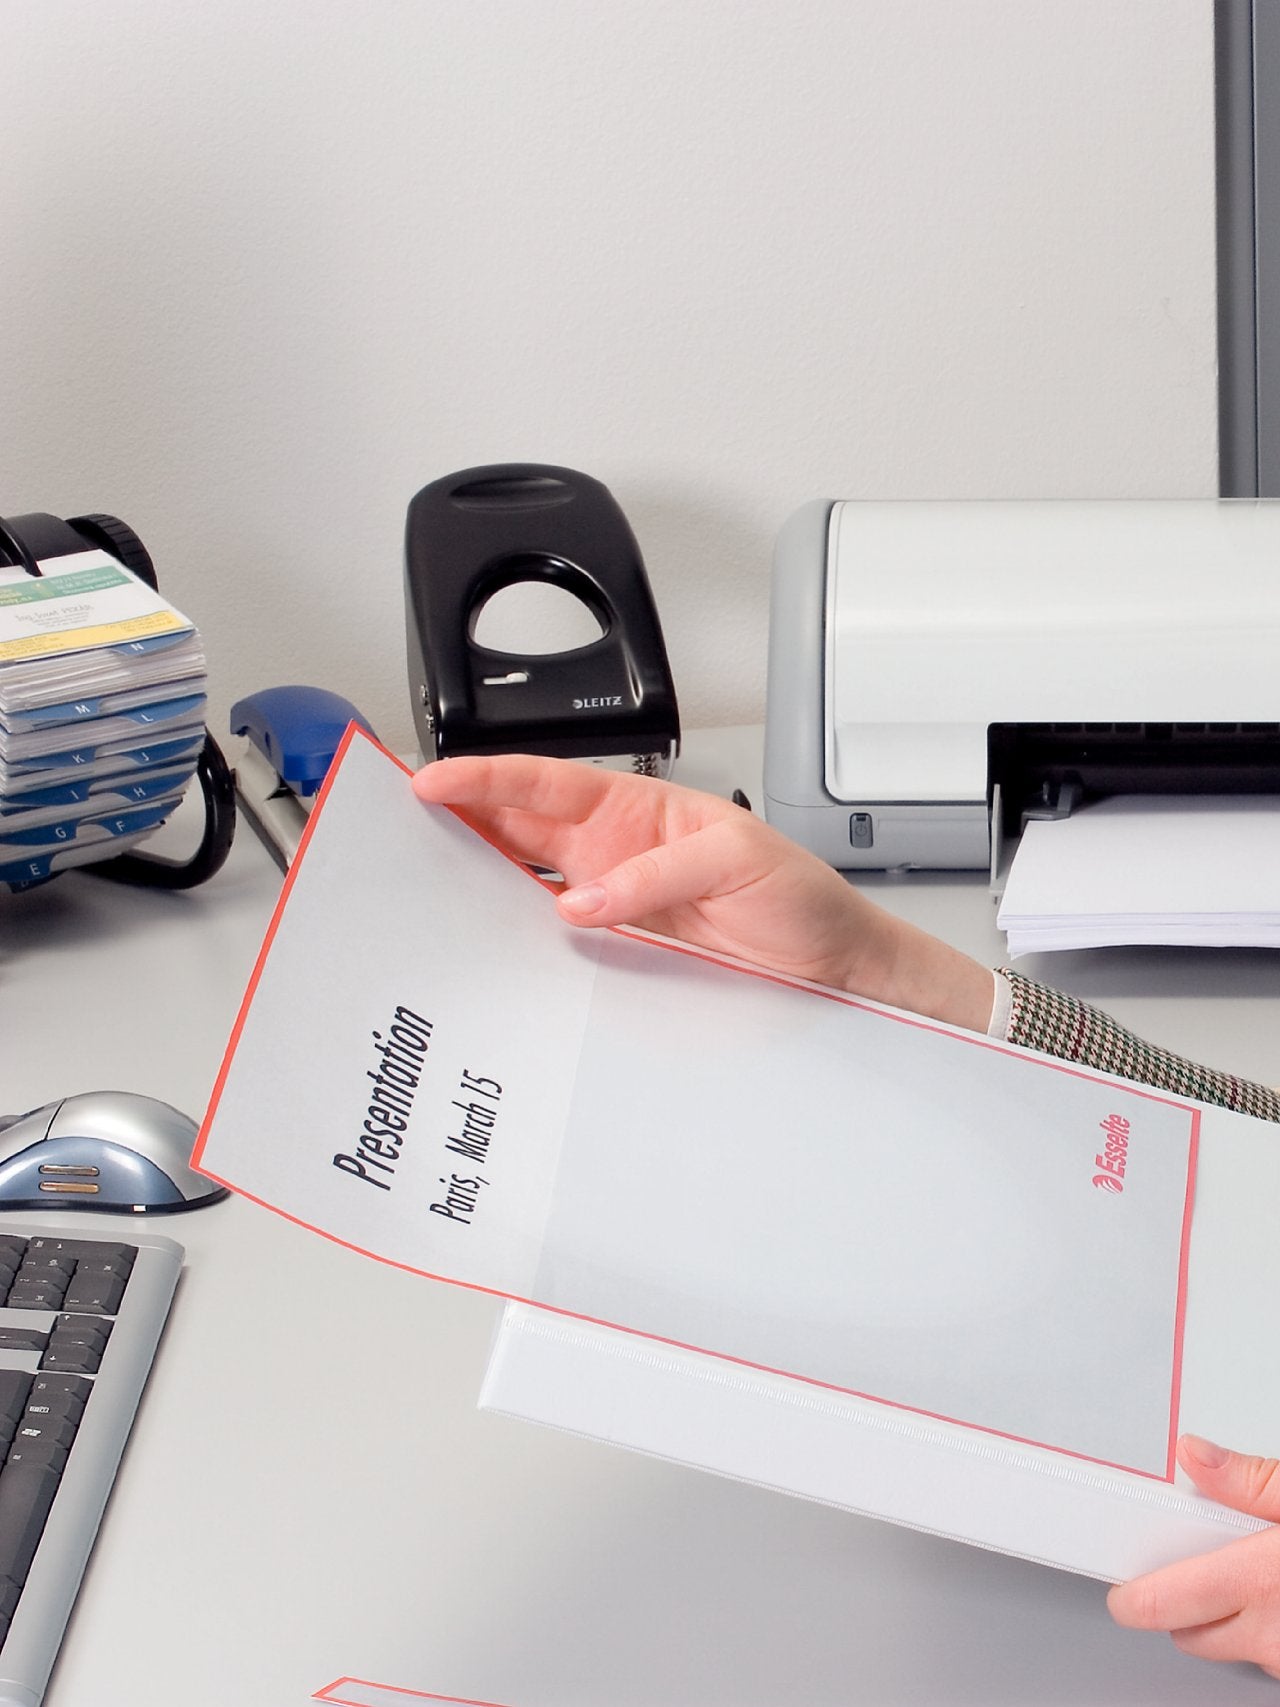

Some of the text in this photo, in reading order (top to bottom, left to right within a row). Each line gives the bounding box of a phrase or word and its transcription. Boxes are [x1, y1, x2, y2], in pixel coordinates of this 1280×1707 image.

[130, 643, 144, 651] N
[584, 696, 622, 708] LEITZ
[75, 704, 91, 714] M
[141, 713, 154, 723] L
[72, 754, 86, 764] K
[142, 752, 150, 762] J
[70, 789, 80, 800] I
[133, 786, 146, 798] H
[55, 826, 67, 838] G
[116, 820, 126, 832] F
[29, 863, 41, 876] E
[332, 1005, 434, 1191] Presentation
[429, 1068, 503, 1225] Paris, March 15
[1095, 1113, 1130, 1178] Esselte
